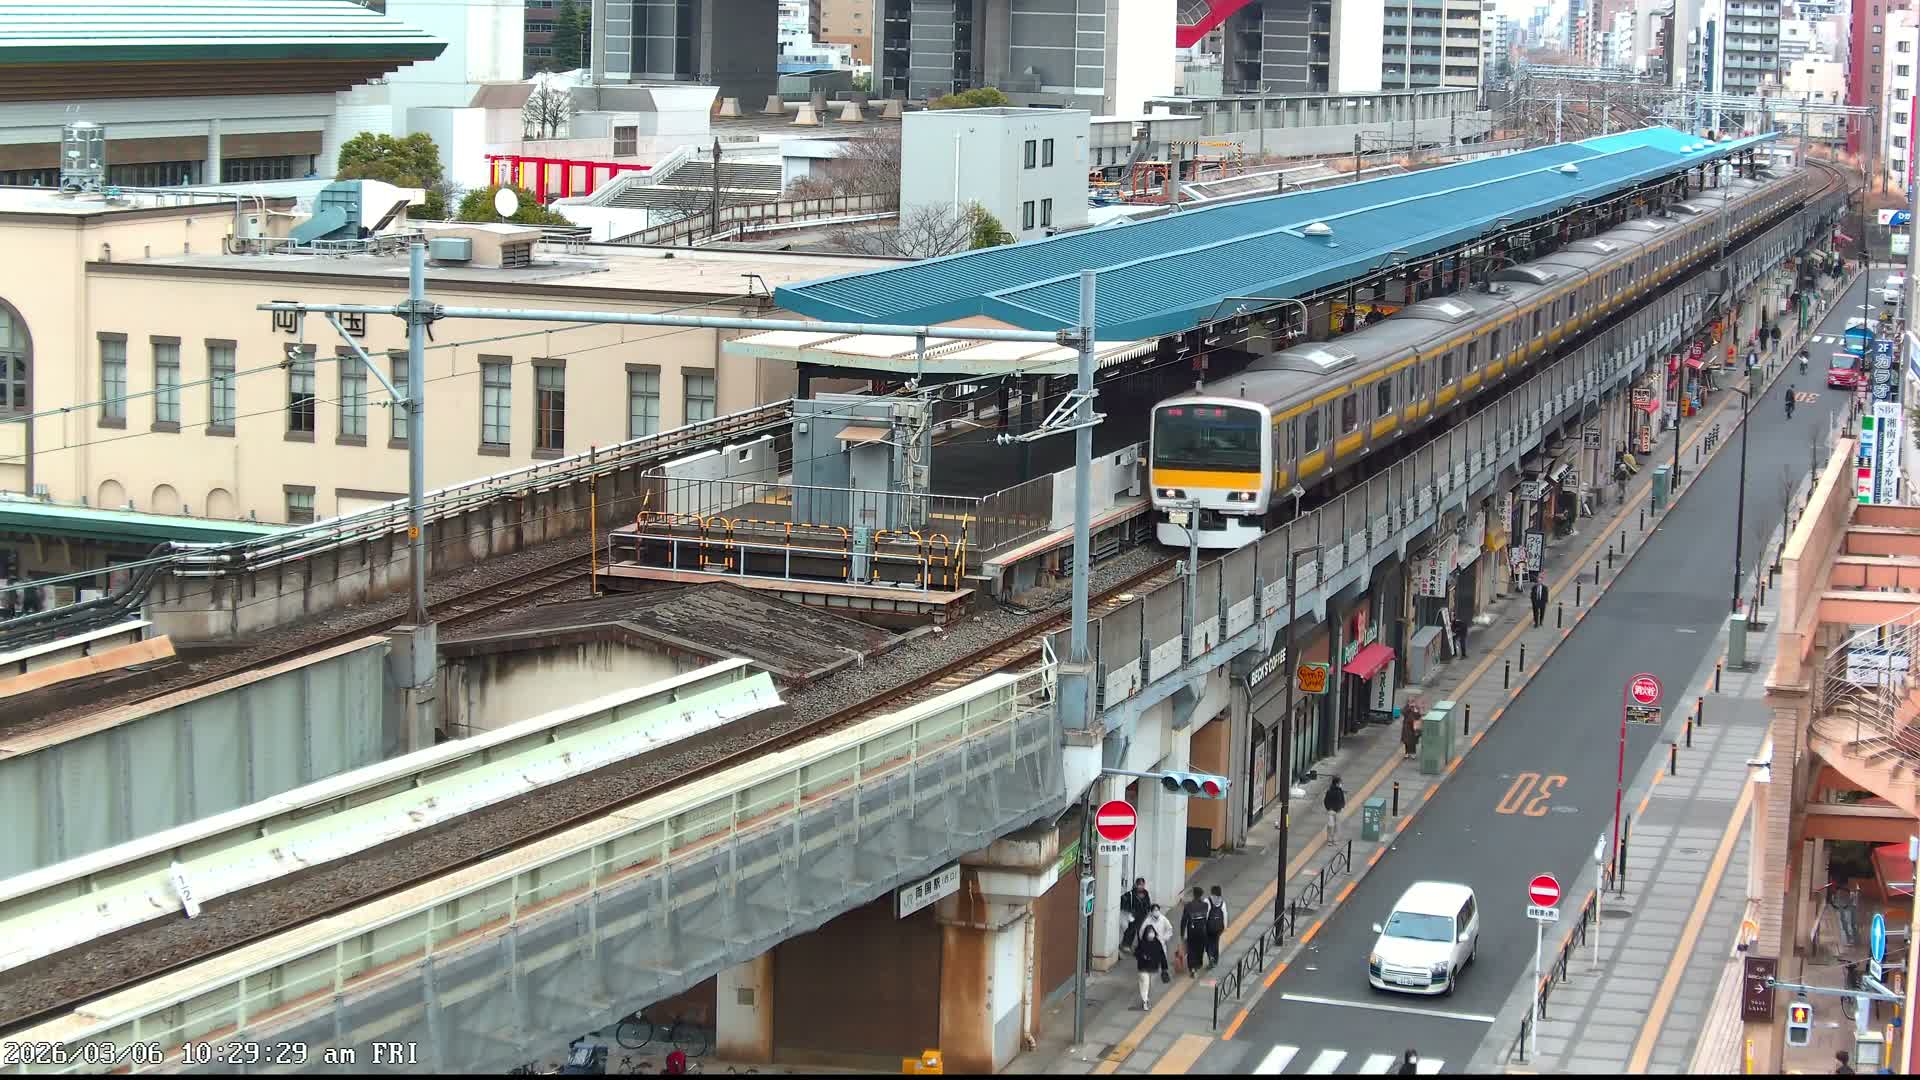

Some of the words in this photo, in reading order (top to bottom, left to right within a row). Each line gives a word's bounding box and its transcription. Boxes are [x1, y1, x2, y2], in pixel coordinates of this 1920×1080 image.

[1878, 343, 1889, 352] 2F
[1874, 353, 1891, 403] カラオ
[1250, 660, 1269, 687] BECK'S
[1268, 647, 1287, 673] COFFEE
